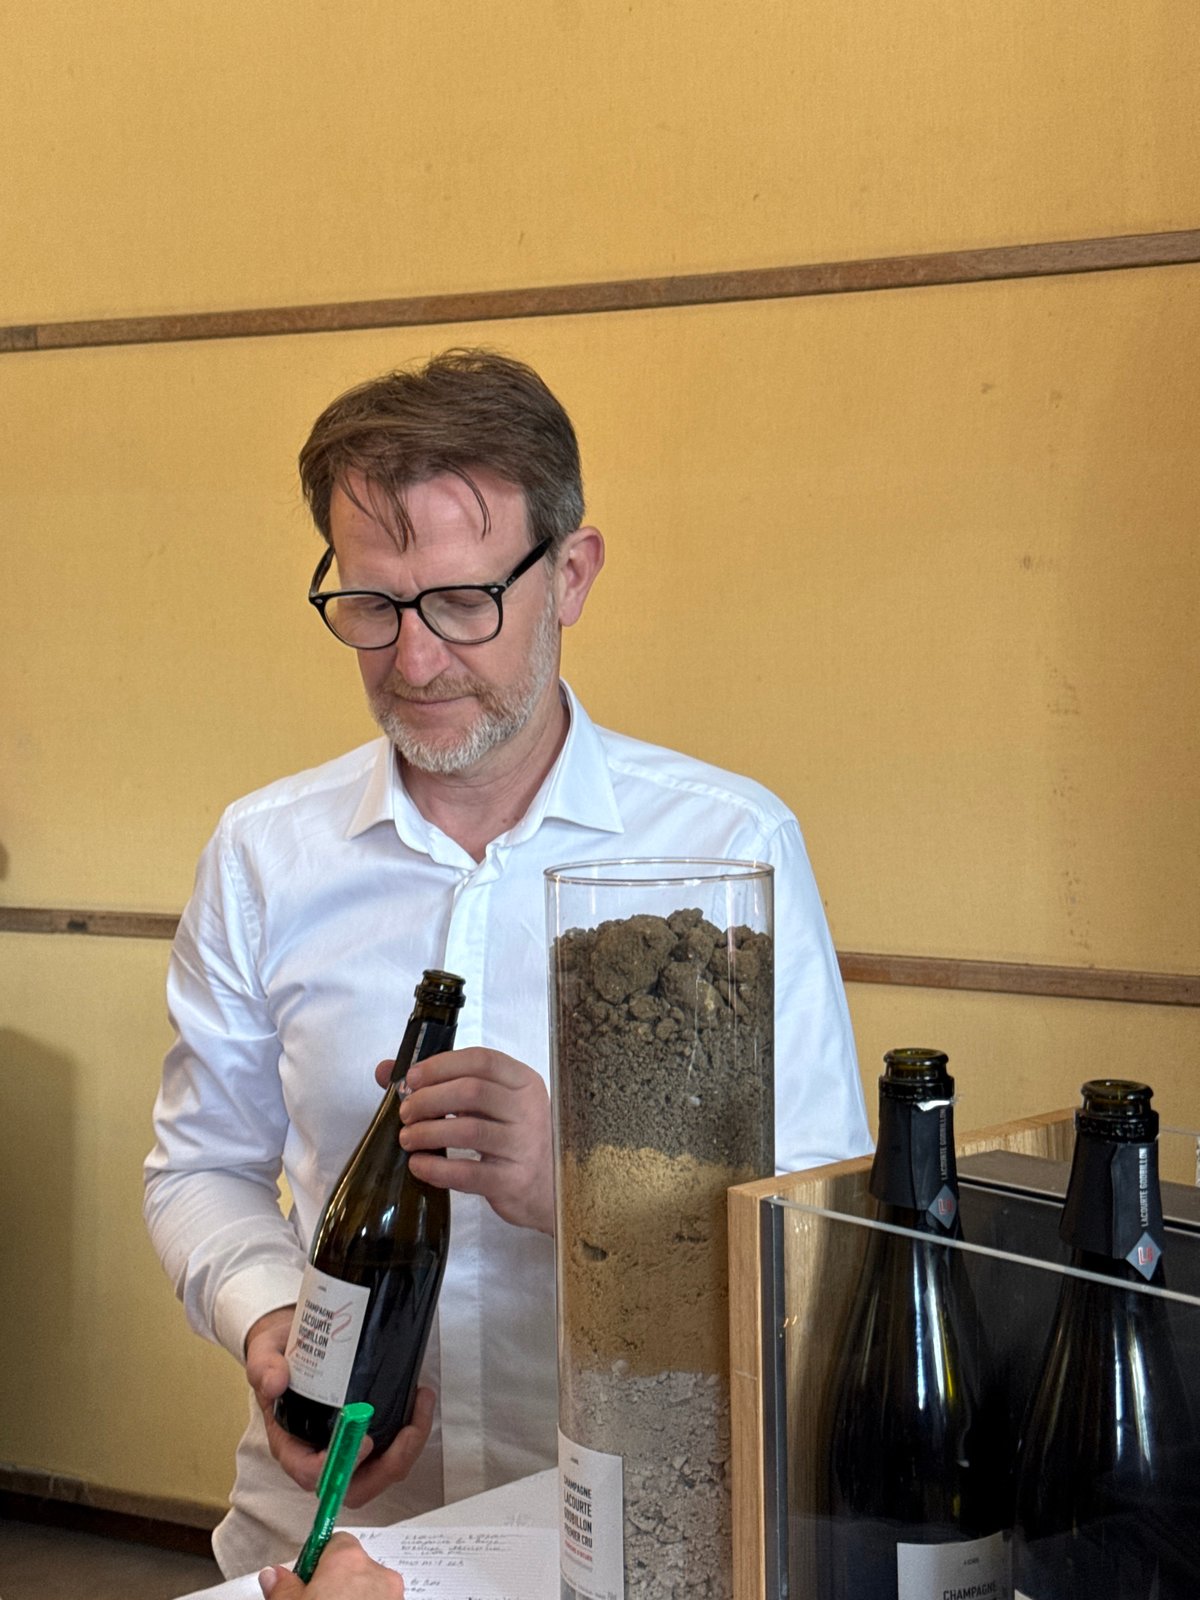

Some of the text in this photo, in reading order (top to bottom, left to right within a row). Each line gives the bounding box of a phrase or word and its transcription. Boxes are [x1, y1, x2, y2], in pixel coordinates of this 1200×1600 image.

[1139, 1189, 1148, 1227] LACOURTE
[304, 1299, 334, 1321] CHAMPAGNE
[301, 1310, 332, 1335] LACOURTE
[313, 1348, 326, 1361] CRU
[563, 1474, 592, 1500] CHAMPAGNE
[563, 1487, 592, 1518] LACOURTE
[581, 1534, 593, 1549] CRU
[943, 1581, 997, 1600] CHAMPAGNE
